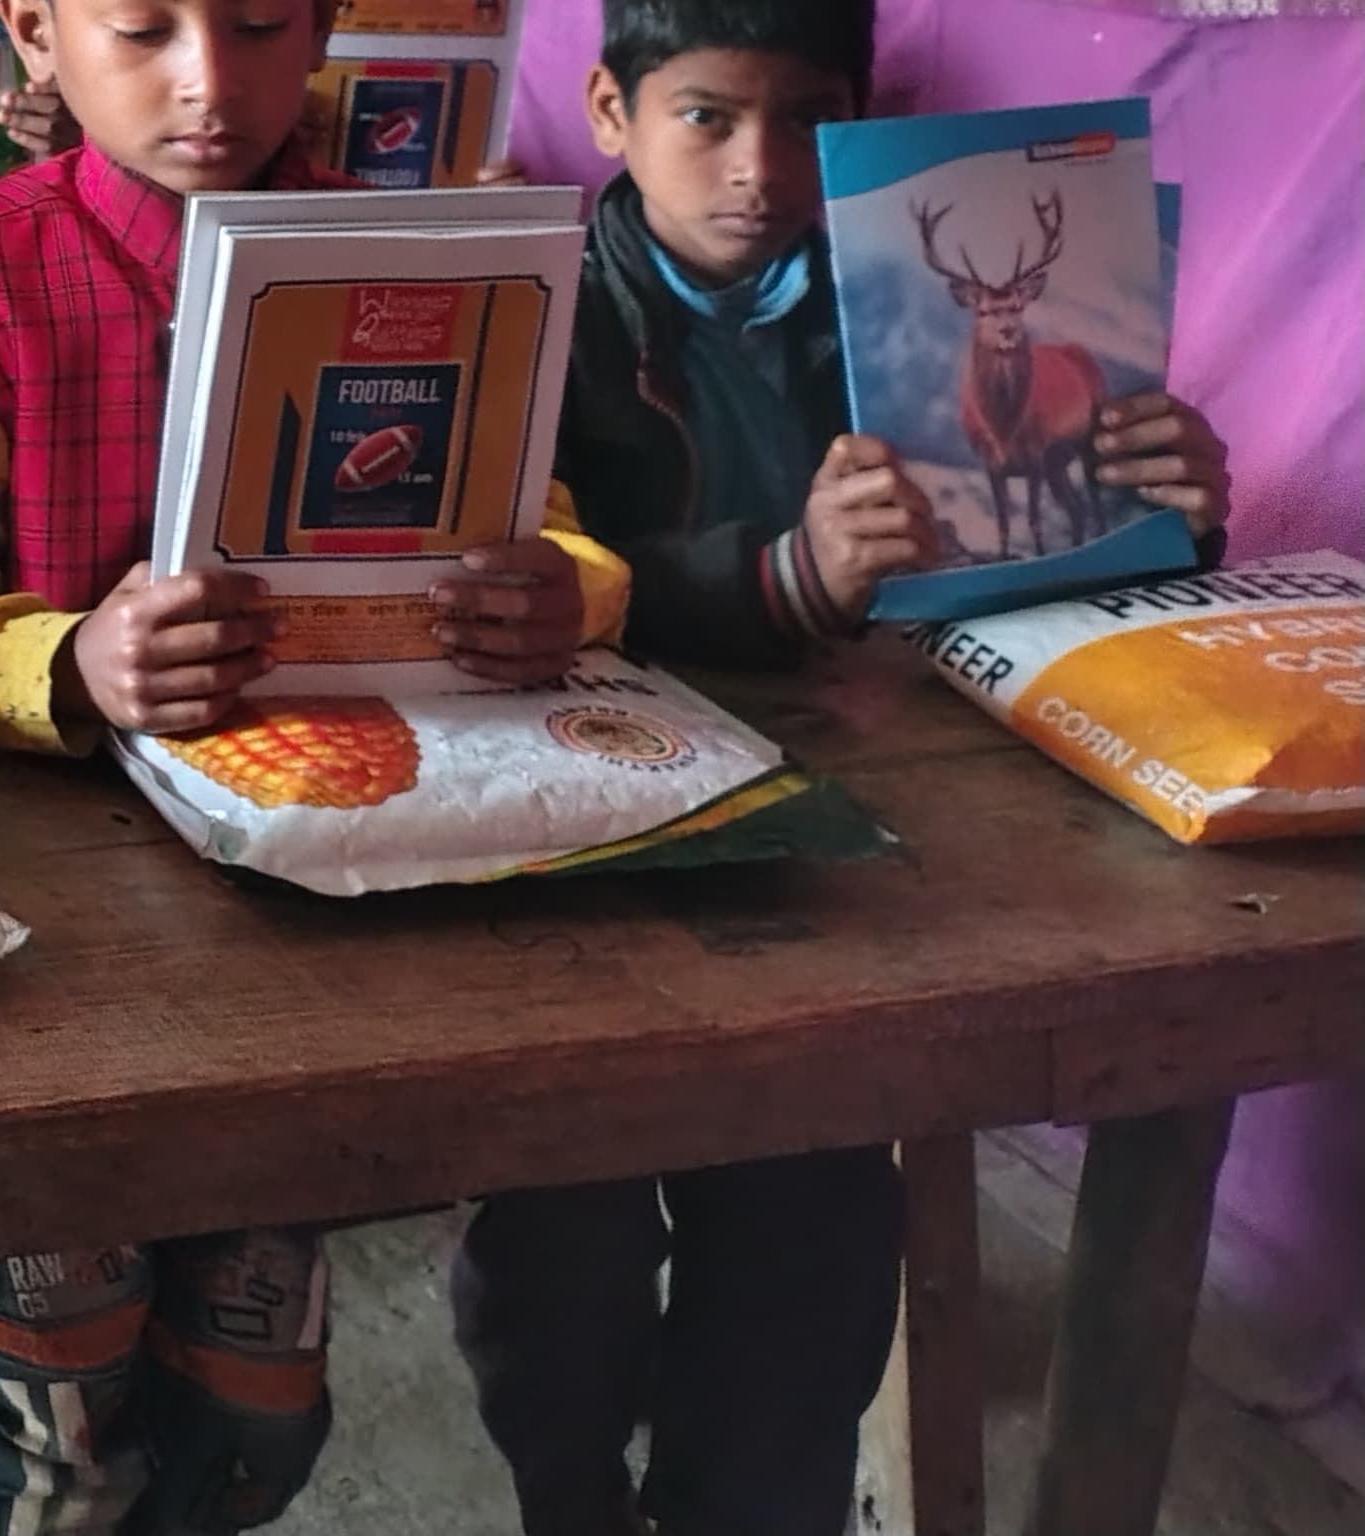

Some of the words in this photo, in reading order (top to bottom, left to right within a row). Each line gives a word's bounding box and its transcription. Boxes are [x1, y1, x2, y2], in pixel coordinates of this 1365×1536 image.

[338, 378, 442, 405] FOOTBALL
[1087, 571, 1365, 619] PIONEER
[1037, 696, 1137, 768] CORN
[1132, 758, 1207, 820] SEE
[7, 1252, 65, 1292] RAW
